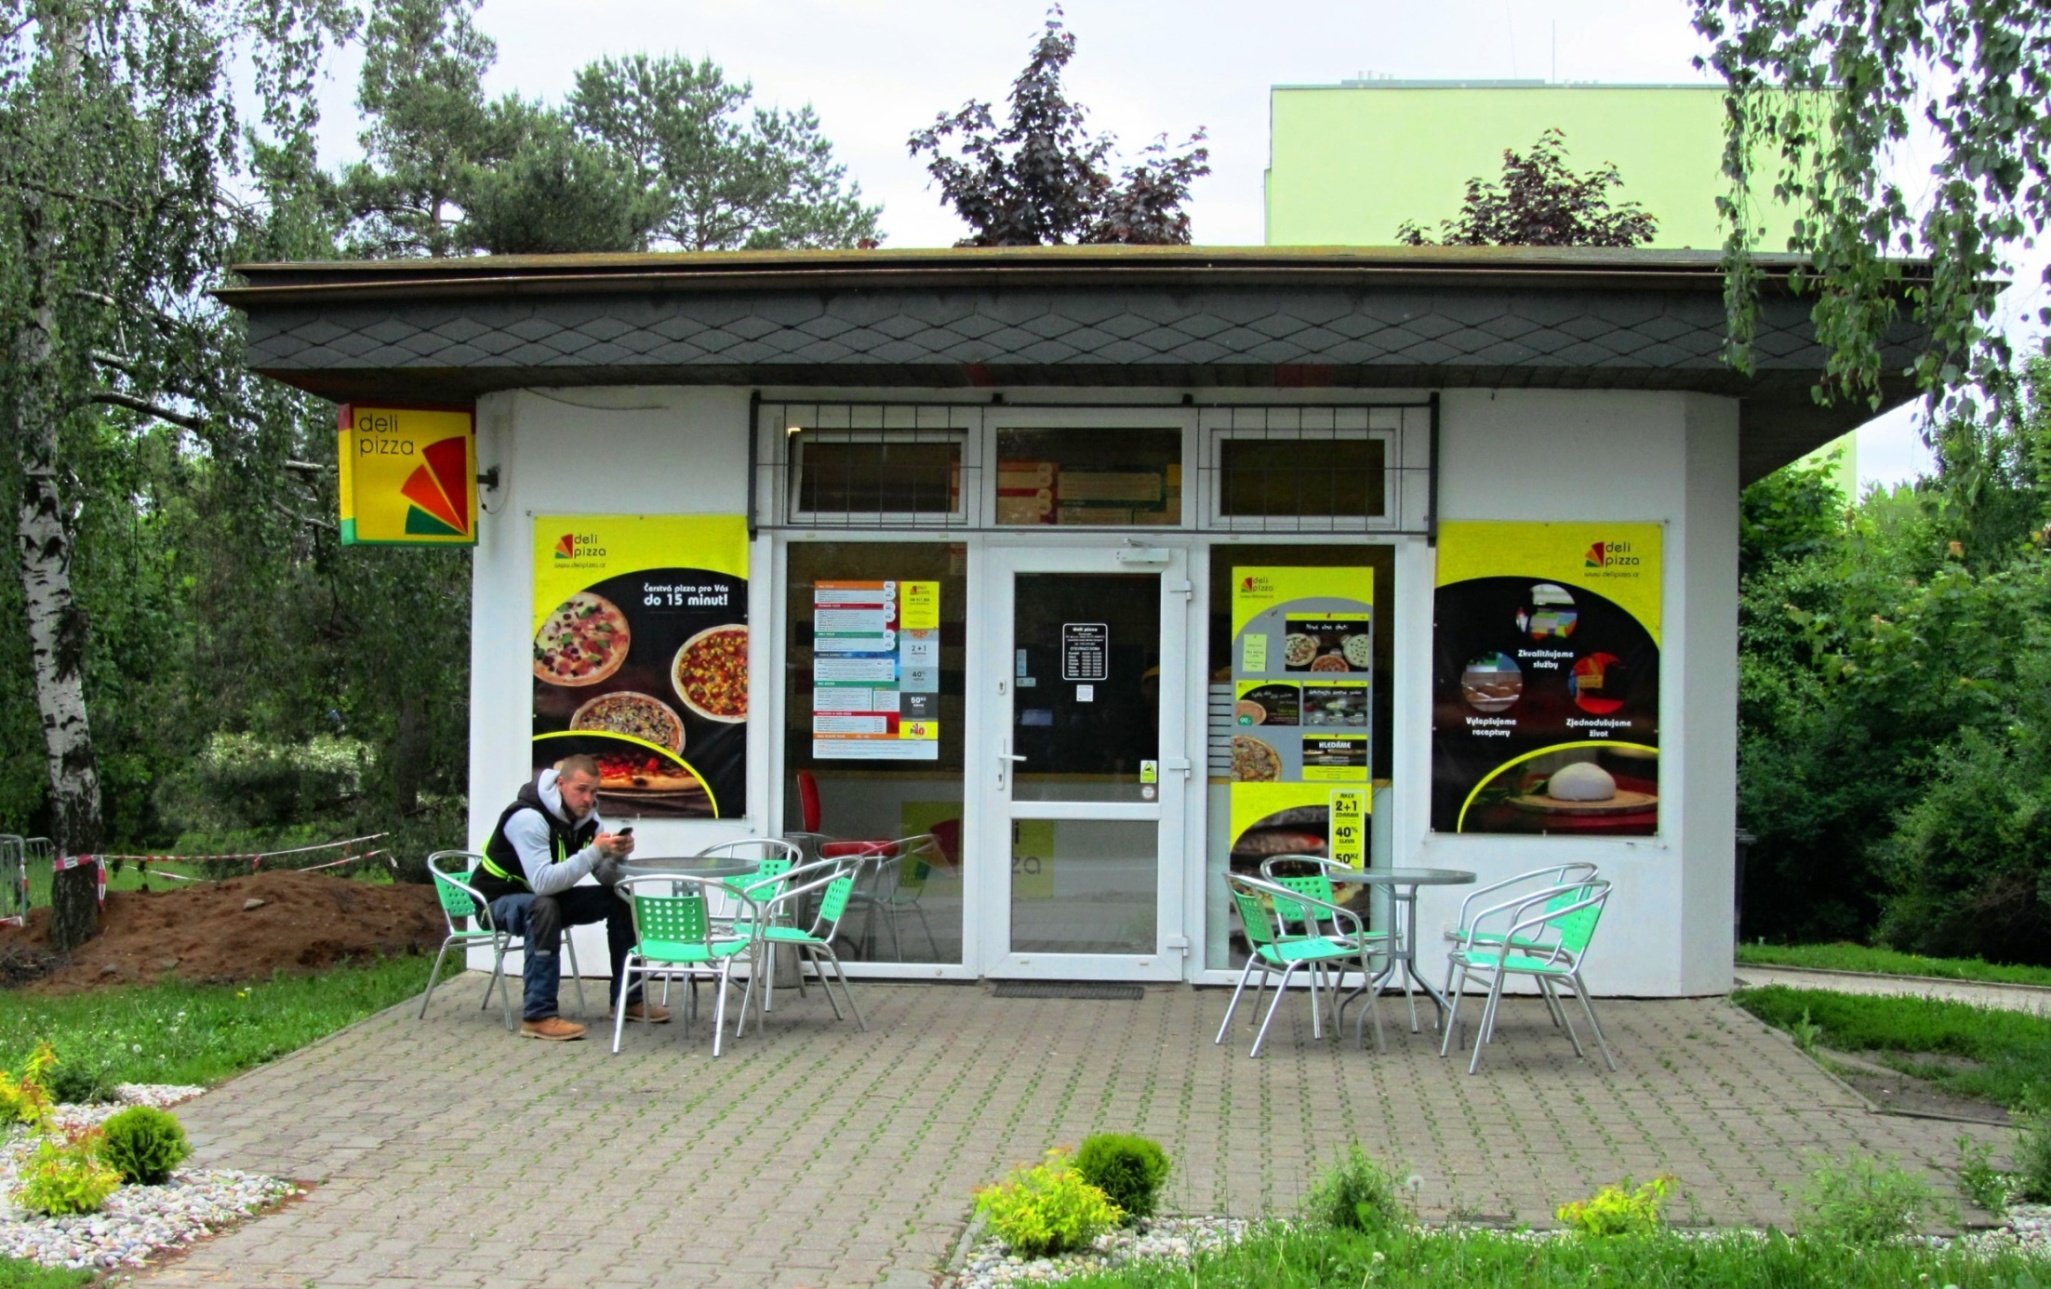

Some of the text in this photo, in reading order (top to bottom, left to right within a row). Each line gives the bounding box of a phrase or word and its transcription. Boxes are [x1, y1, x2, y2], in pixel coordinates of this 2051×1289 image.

[359, 413, 398, 433] deli
[360, 435, 414, 457] pizza
[574, 533, 598, 545] deli
[1605, 541, 1631, 553] deli
[574, 547, 607, 559] pizza
[1605, 554, 1640, 568] pizza
[1253, 576, 1268, 584] deli
[643, 583, 729, 594] Čerstvá pizza pro Vás
[643, 594, 728, 606] do 15 minut!
[1518, 650, 1574, 660] Zkvalitňujeme
[1533, 660, 1559, 670] služby
[1466, 717, 1517, 727] Vylepšujeme
[1566, 718, 1632, 728] Zjednodušujeme
[1472, 728, 1511, 738] receptury
[1589, 728, 1609, 738] život
[1318, 741, 1352, 749] HLEDÁME
[1335, 826, 1359, 838] 40%
